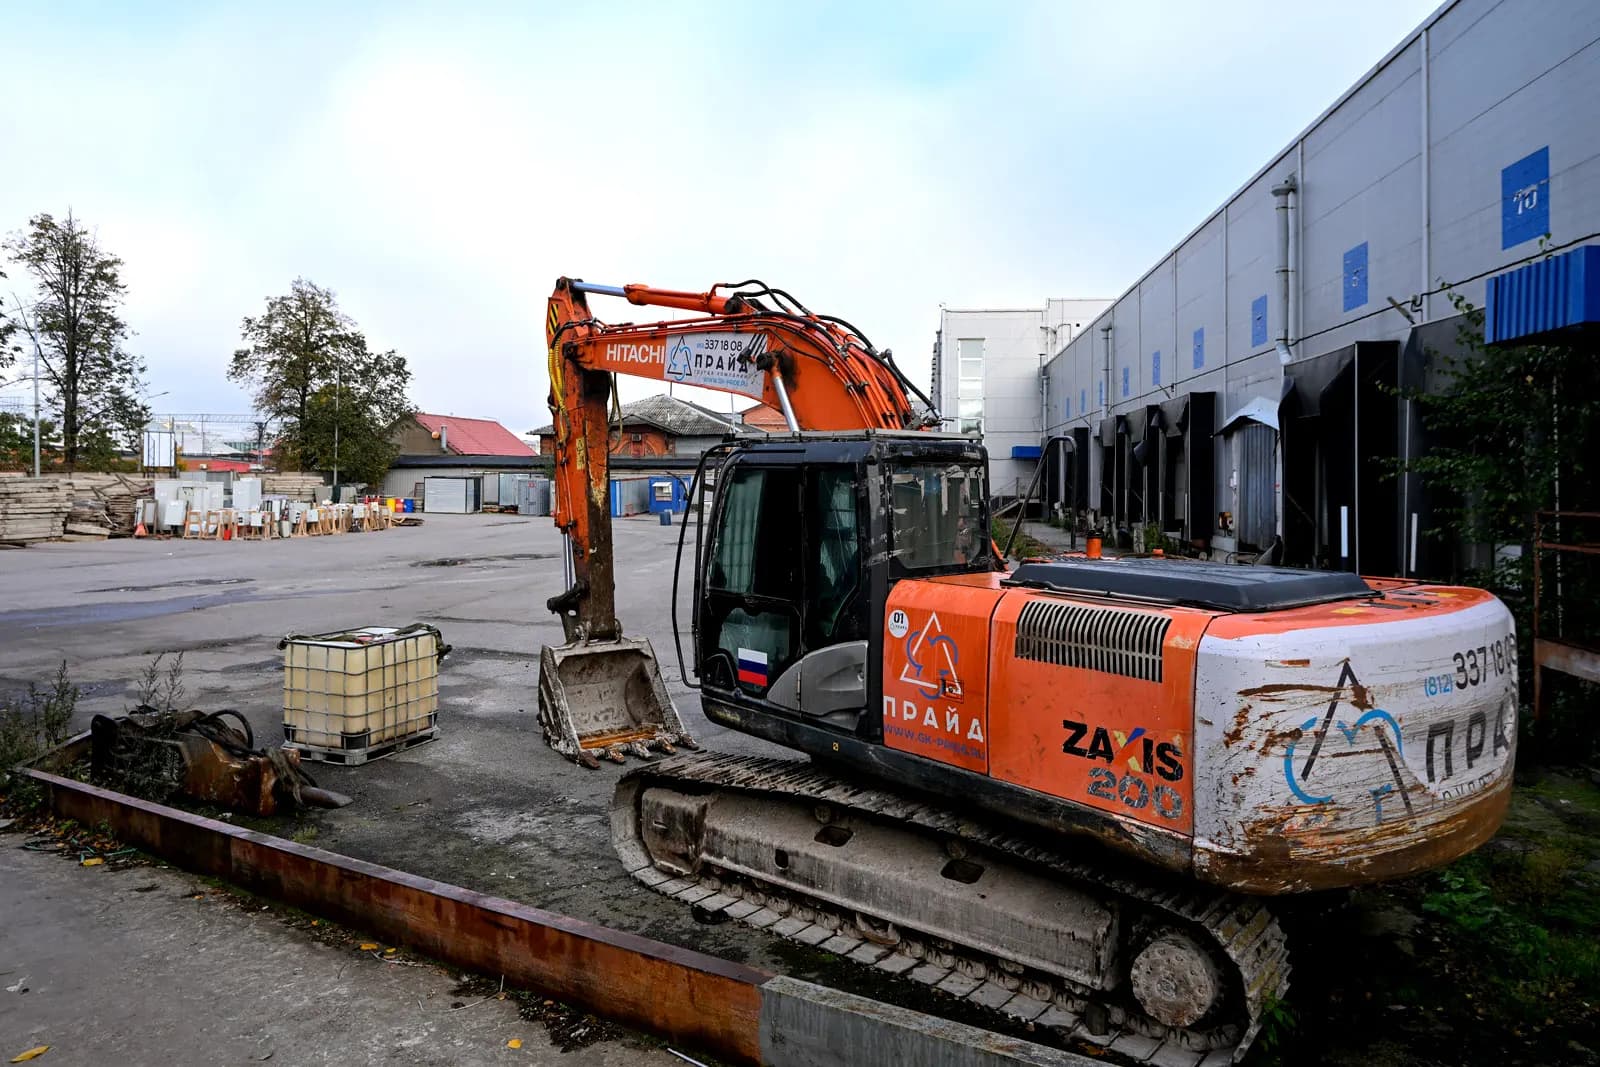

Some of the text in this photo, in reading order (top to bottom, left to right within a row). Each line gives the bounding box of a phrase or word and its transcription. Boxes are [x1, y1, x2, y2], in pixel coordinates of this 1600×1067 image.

[606, 343, 665, 363] HITACHI
[704, 339, 719, 350] 337
[720, 340, 729, 351] 18
[730, 340, 743, 352] 08
[694, 353, 748, 374] ПРАЙД
[894, 612, 904, 625] 01
[1424, 673, 1453, 698] (812)
[1453, 646, 1488, 690] 337
[883, 695, 984, 743] ПРАЙД
[1062, 719, 1184, 782] ZAXIS
[1087, 767, 1183, 819] 200
